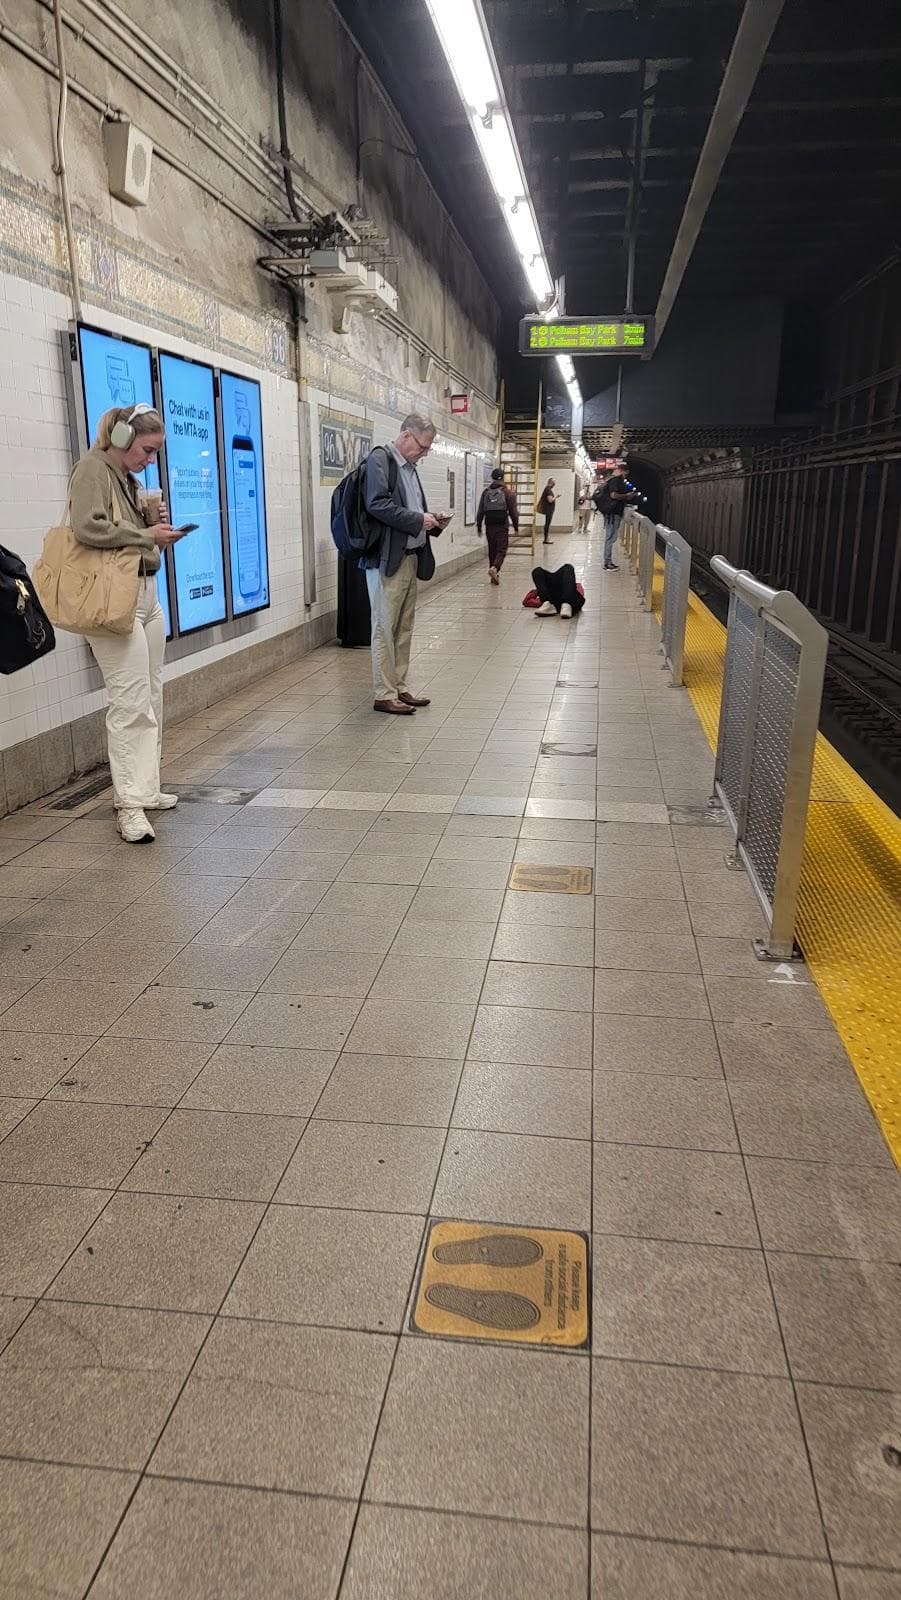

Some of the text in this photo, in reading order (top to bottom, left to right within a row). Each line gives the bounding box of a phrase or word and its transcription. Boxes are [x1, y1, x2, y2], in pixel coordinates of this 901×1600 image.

[168, 399, 210, 421] Chat with us in
[173, 421, 209, 442] the MTA app
[324, 431, 336, 463] 96
